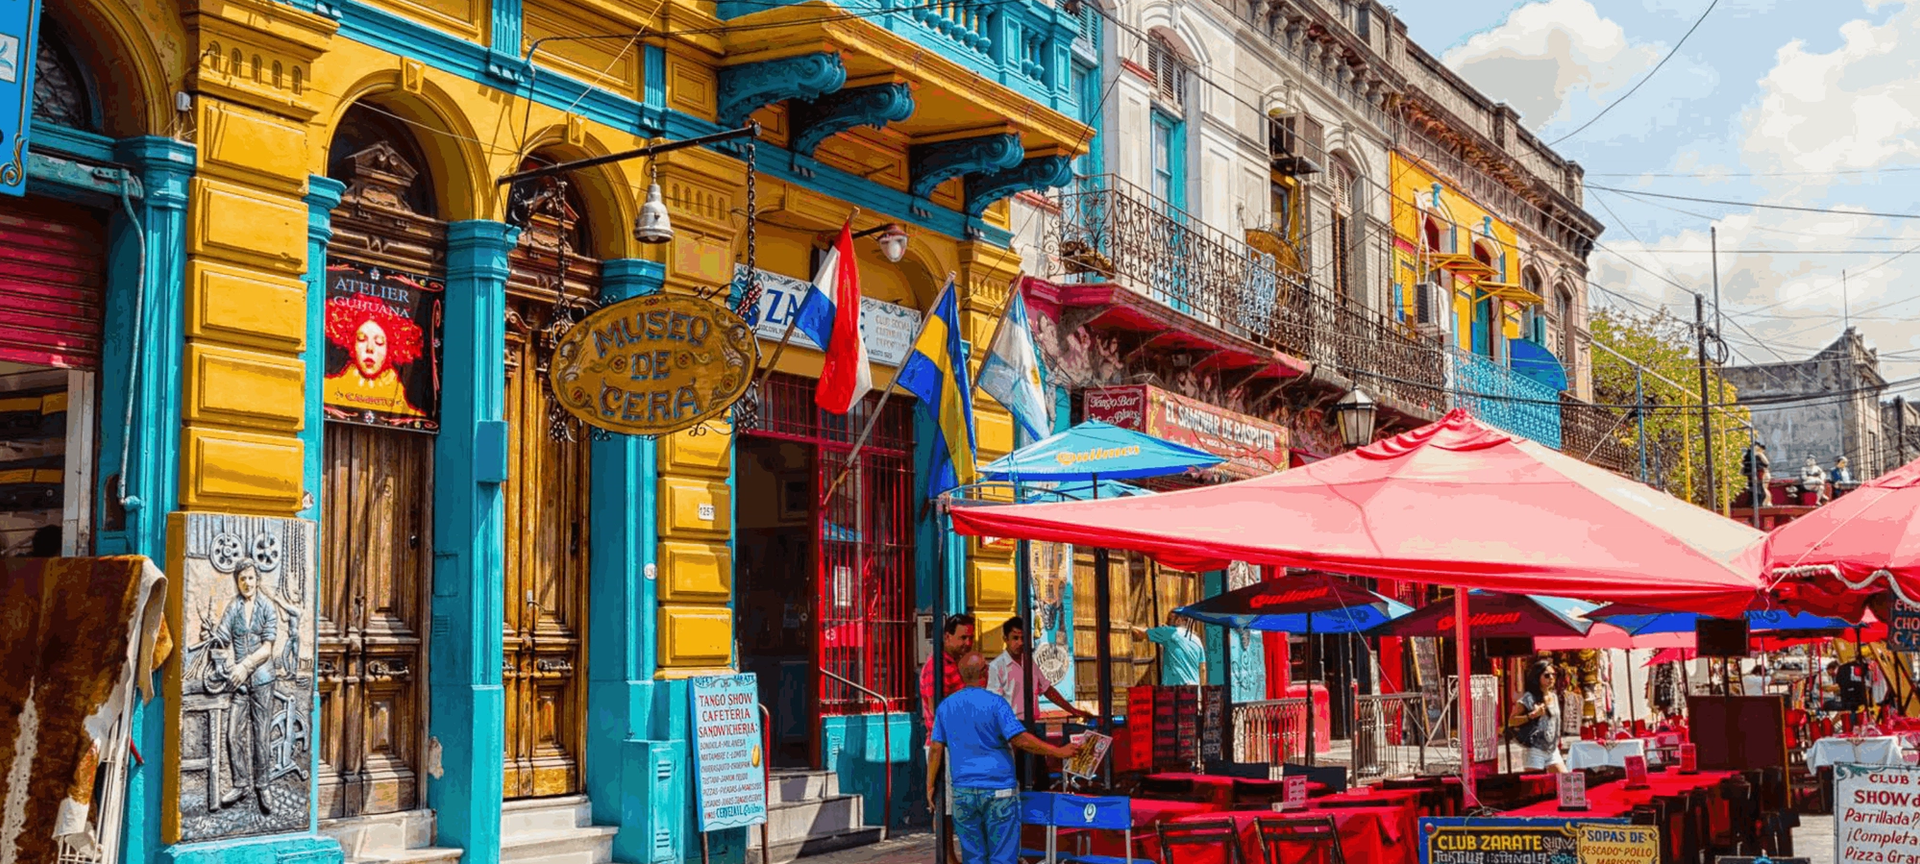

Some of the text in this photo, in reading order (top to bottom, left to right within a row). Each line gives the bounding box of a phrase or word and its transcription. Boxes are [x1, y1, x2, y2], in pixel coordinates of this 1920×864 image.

[335, 277, 410, 303] ATELIER
[592, 310, 710, 358] MUSEO
[631, 350, 670, 380] DE
[1090, 394, 1139, 410] Tango Bar
[1178, 404, 1220, 437] SAMOVAR
[1222, 418, 1233, 440] DE
[1056, 445, 1140, 466] Quilmes
[699, 692, 752, 707] TANGO SHOW
[702, 708, 751, 722] CAFETERIA
[1869, 773, 1910, 785] CLUB
[1854, 789, 1911, 807] SHOW
[1844, 807, 1910, 825] Parrillada
[1437, 835, 1477, 850] CLUB
[1480, 835, 1543, 850] ZARATE
[1587, 830, 1626, 842] SOPAS
[1624, 847, 1653, 857] POLLO
[1845, 846, 1884, 862] Pizza
